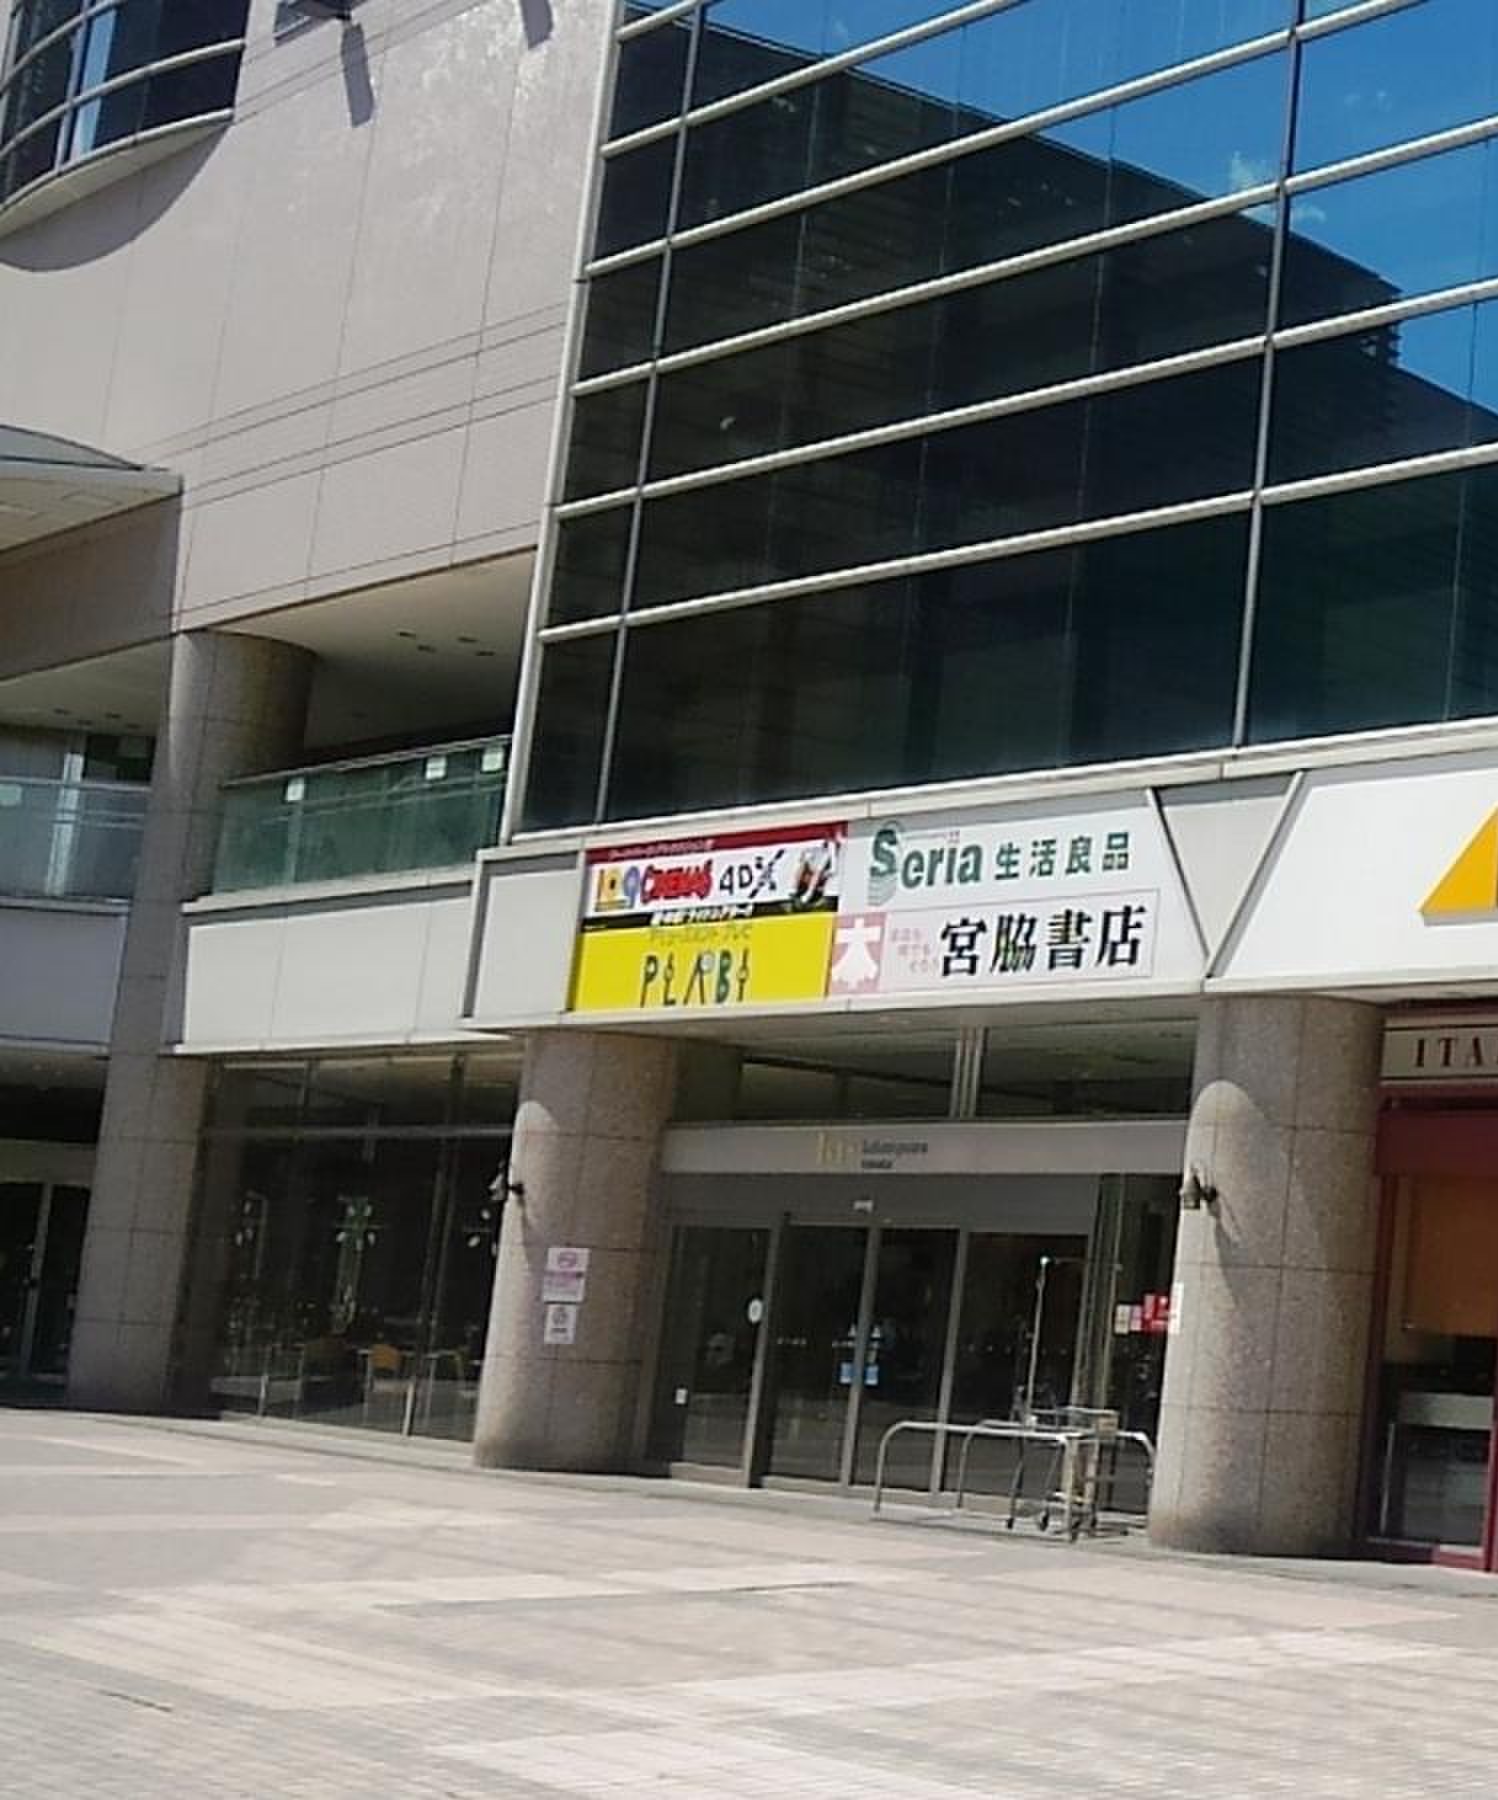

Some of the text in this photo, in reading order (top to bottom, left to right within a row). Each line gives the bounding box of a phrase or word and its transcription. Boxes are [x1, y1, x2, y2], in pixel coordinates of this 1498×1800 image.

[719, 849, 785, 899] 4DX
[869, 826, 983, 889] Seria
[994, 832, 1130, 881] 生活良品
[940, 905, 1147, 977] 宮脇書店
